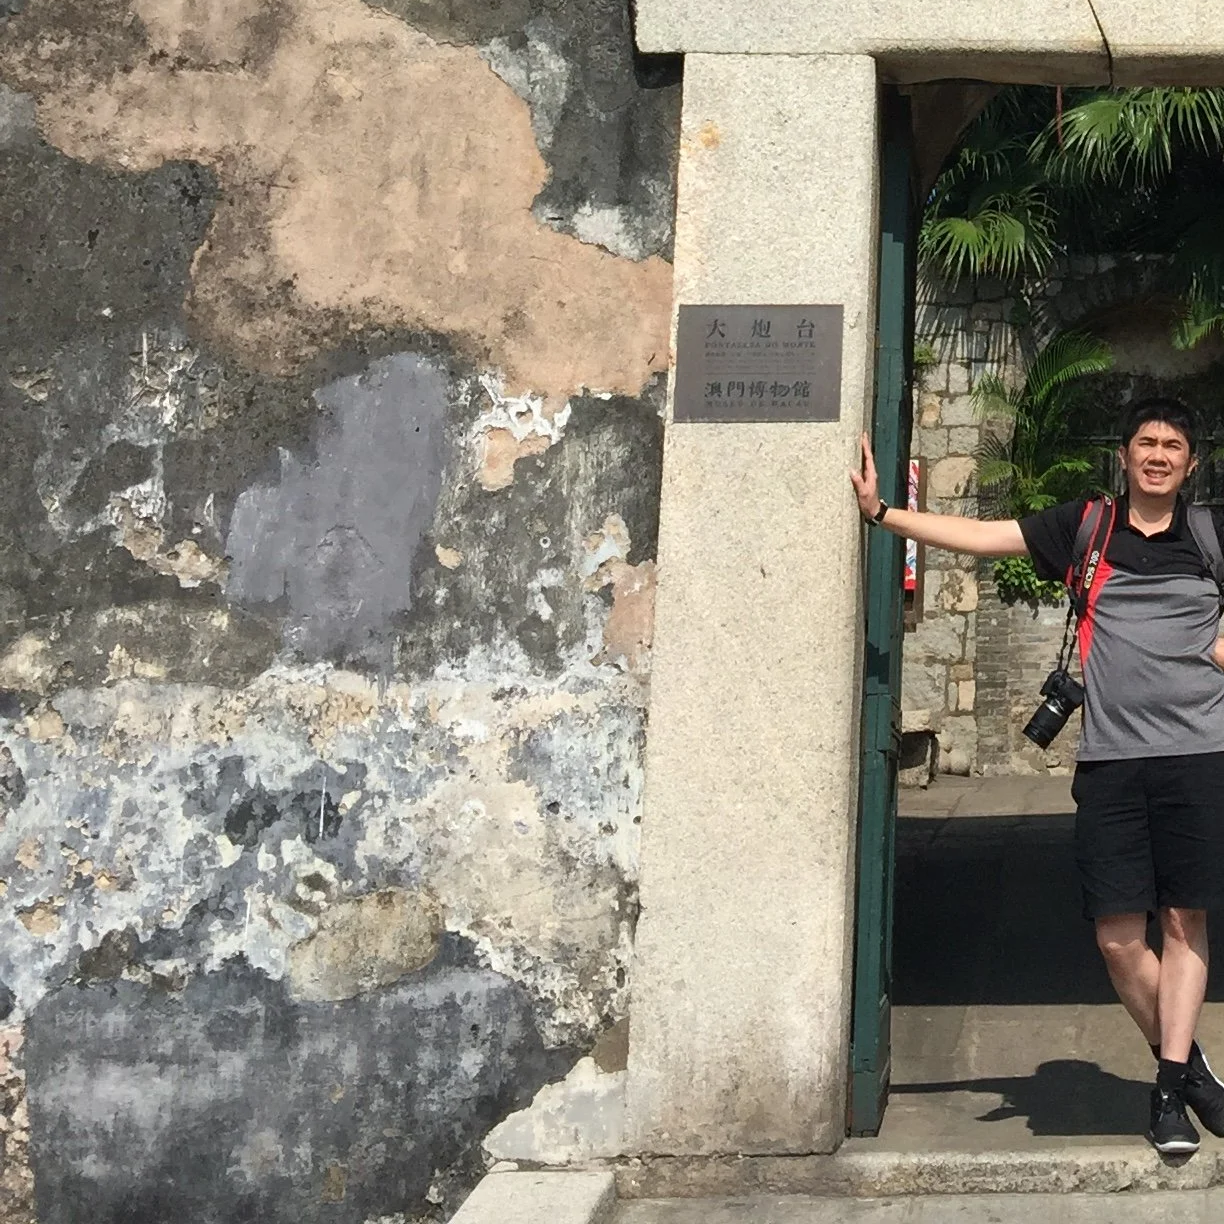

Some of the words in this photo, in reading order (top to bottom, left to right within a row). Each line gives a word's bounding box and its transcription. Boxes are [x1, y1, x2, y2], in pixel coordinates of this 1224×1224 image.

[704, 318, 816, 339] 大炮台
[704, 380, 812, 399] 澳門博物館
[1084, 566, 1096, 589] EOS
